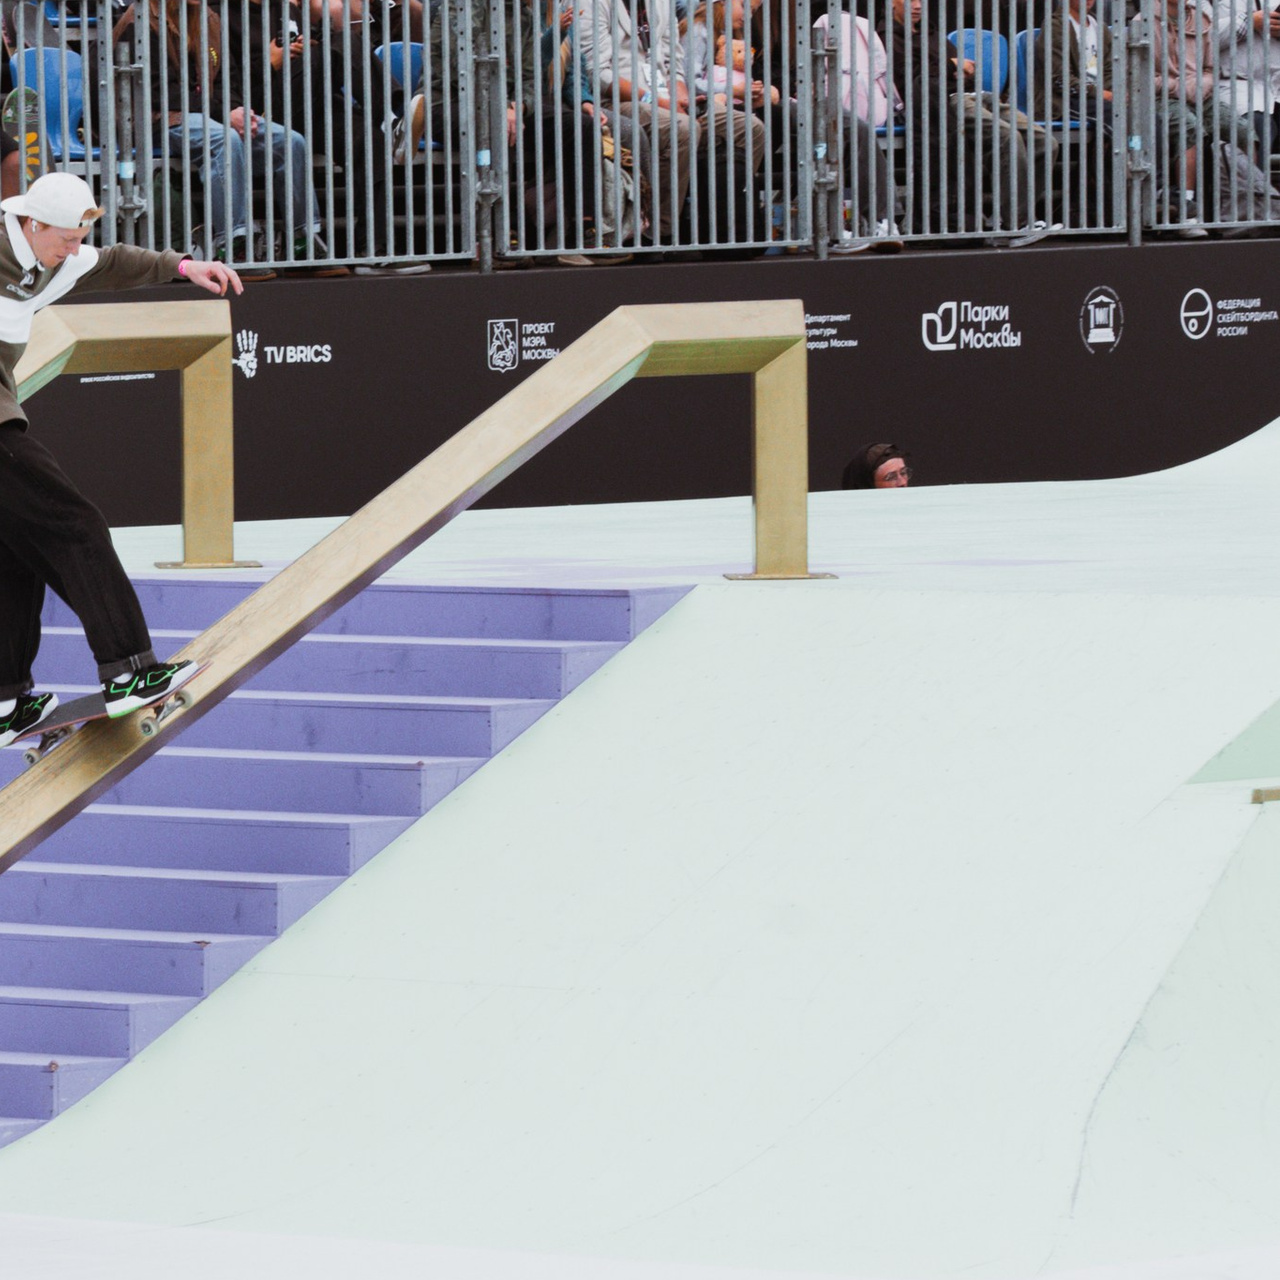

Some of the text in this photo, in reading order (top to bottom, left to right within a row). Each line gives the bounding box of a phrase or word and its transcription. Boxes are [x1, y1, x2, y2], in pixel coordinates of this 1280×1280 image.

[1216, 298, 1262, 310] ФЕДЕРАЦИЯ
[960, 301, 1009, 332] Парки
[1216, 310, 1279, 324] СКЕЙТБОРДИНГА
[522, 322, 556, 335] ПРОЕКТ
[805, 327, 838, 338] ультуры
[1217, 327, 1248, 337] РОССИИ
[522, 336, 547, 348] МЭРА
[960, 323, 1022, 350] Москвы
[806, 341, 828, 351] орода
[263, 344, 332, 364] TV BRICS
[522, 348, 560, 360] МОСКВЫ
